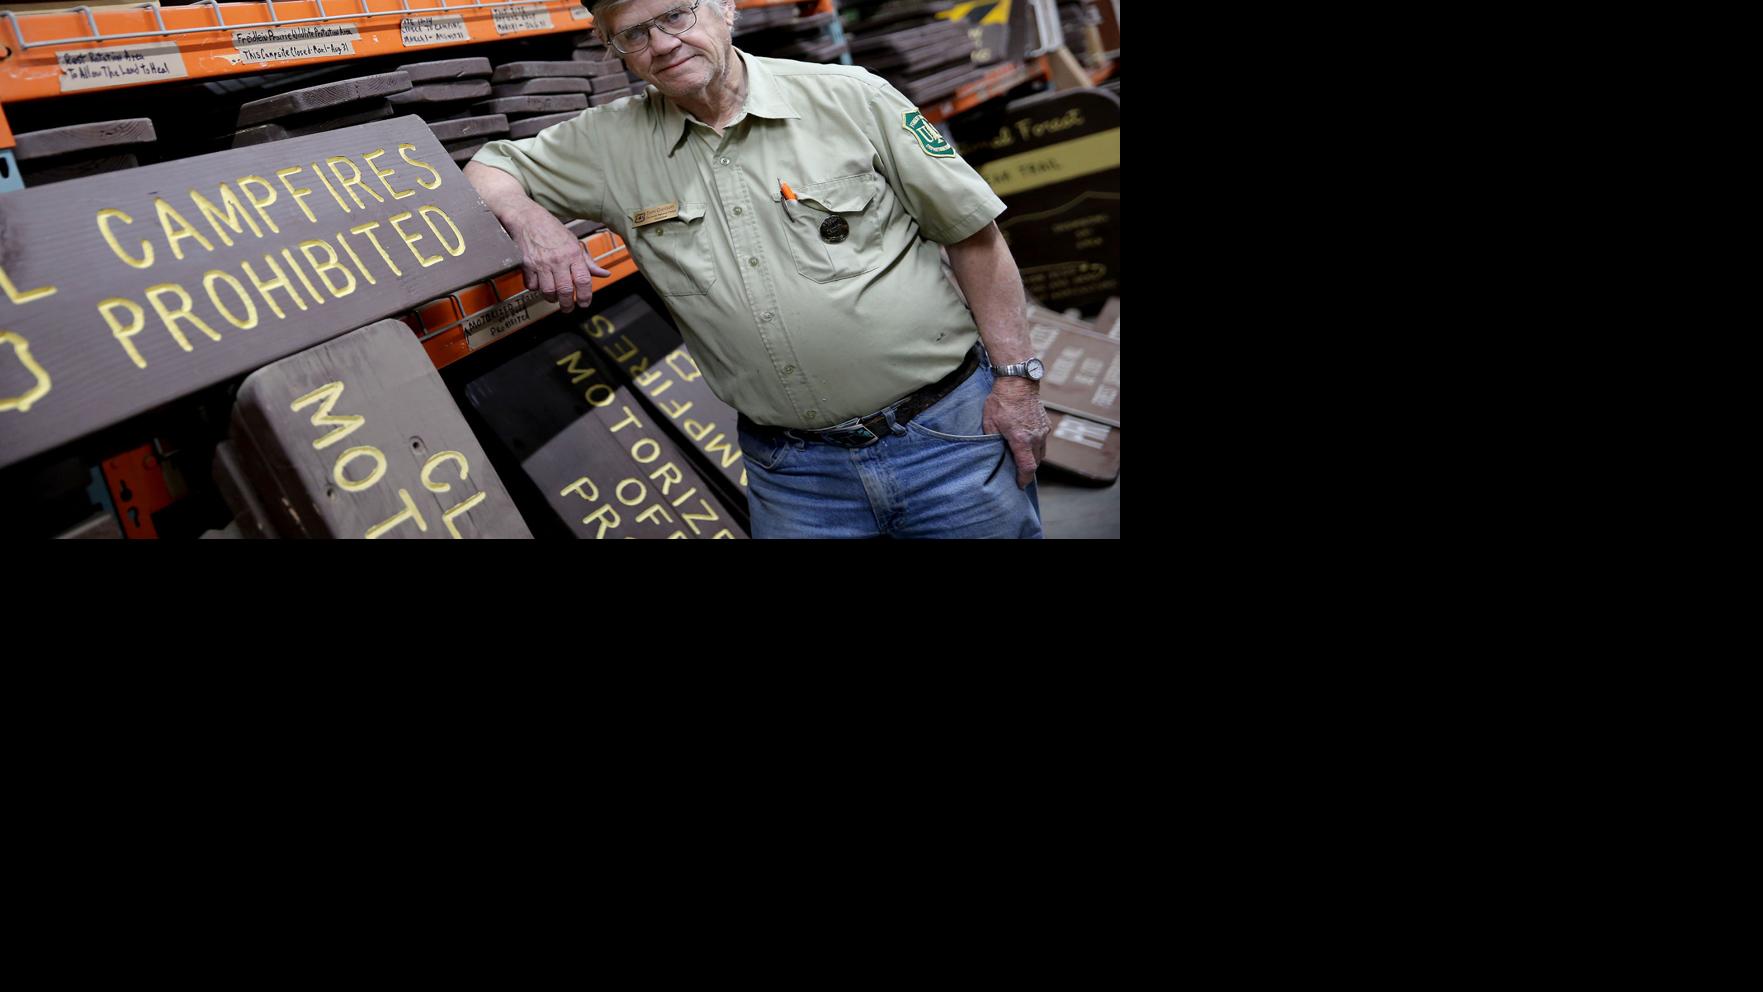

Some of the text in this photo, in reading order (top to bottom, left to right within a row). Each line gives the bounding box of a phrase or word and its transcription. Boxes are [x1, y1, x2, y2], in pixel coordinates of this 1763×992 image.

[67, 68, 78, 79] To
[79, 66, 101, 79] Allow
[101, 66, 119, 78] The
[119, 64, 139, 75] Land
[150, 62, 170, 74] Heal
[242, 50, 261, 60] This
[260, 47, 290, 60] Campsite
[97, 143, 443, 269] CAMPFIRES
[98, 205, 467, 369] PROHIBITED
